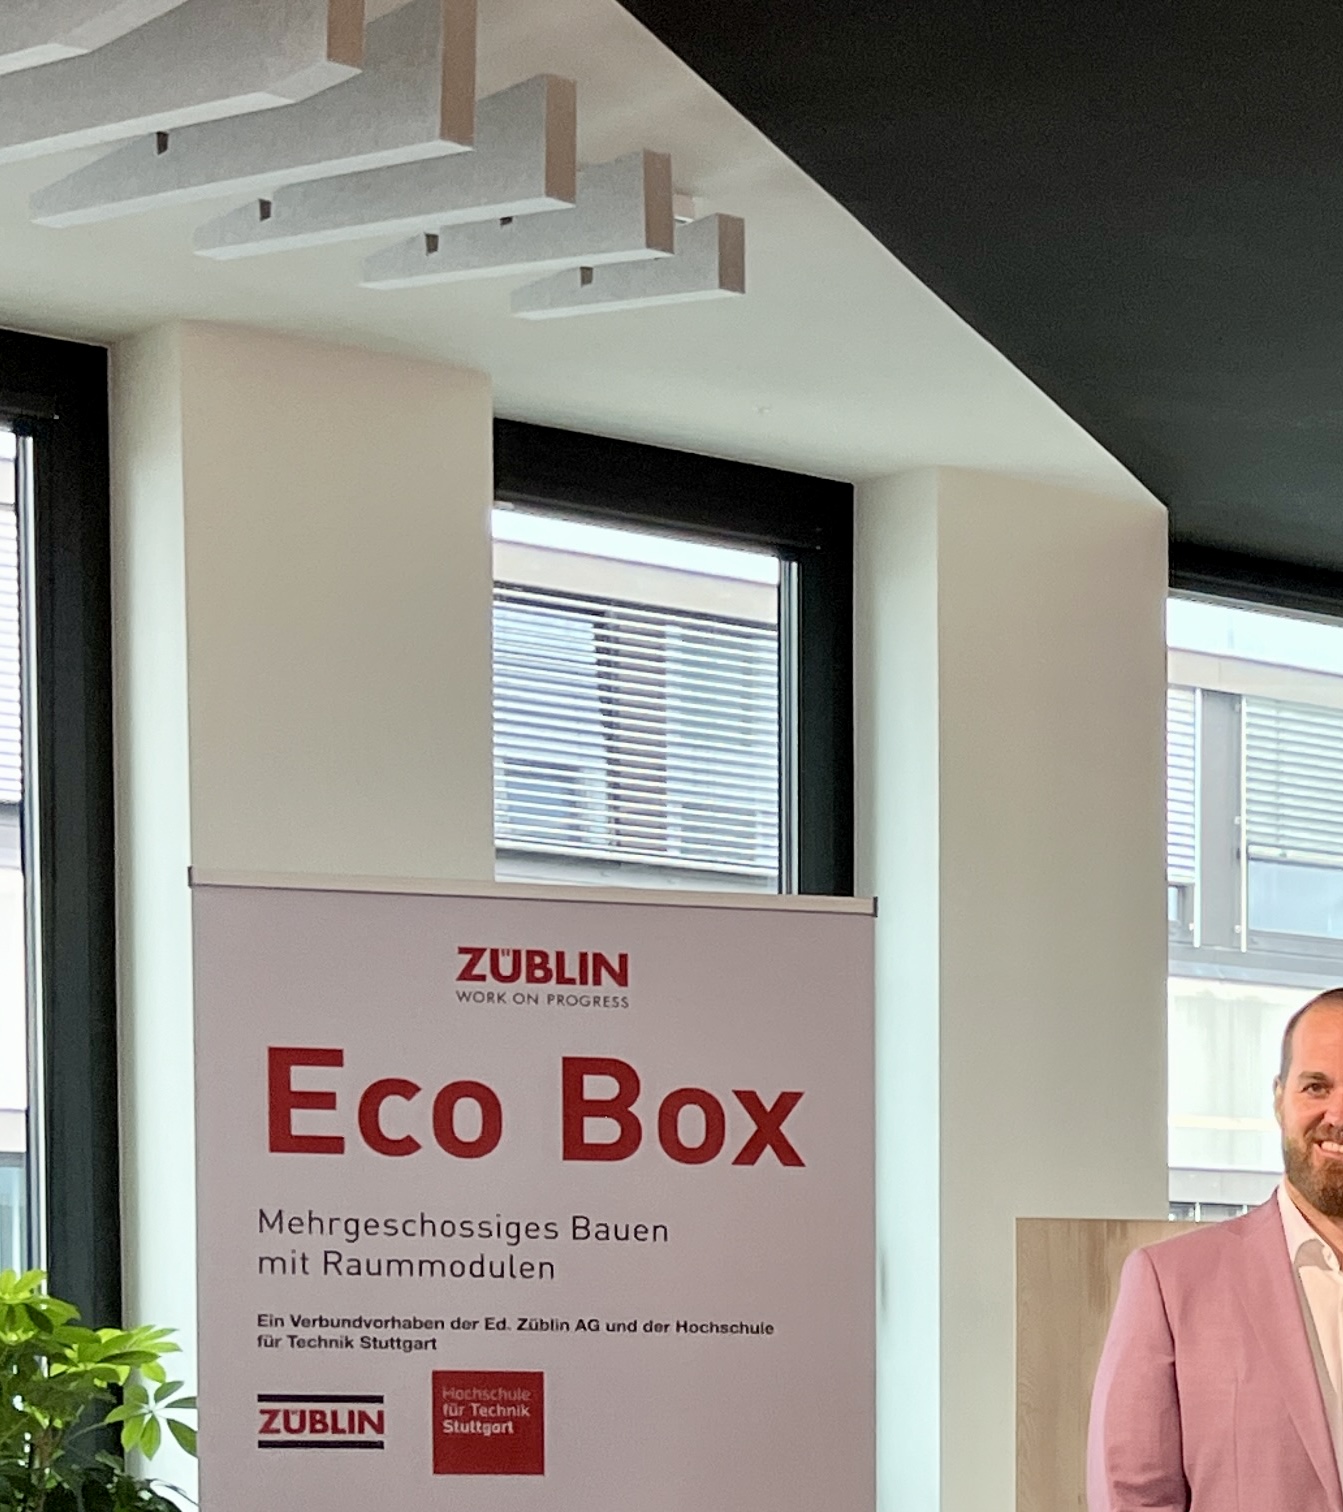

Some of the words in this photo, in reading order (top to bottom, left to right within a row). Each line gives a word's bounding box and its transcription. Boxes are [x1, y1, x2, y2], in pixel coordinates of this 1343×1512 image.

[456, 946, 629, 987] ZÜBLIN
[456, 990, 507, 1005] WORK
[512, 992, 539, 1006] ON
[546, 993, 630, 1009] PROGRESS
[266, 1045, 503, 1160] Eco
[560, 1056, 807, 1168] Box
[257, 1208, 559, 1246] Mehrgeschossiges
[570, 1214, 669, 1243] Bauen
[257, 1250, 310, 1278] mit
[323, 1251, 556, 1281] Raummodulen
[257, 1313, 285, 1328] Ein
[289, 1313, 445, 1331] Verbundvorhaben
[449, 1316, 480, 1331] der
[484, 1317, 512, 1332] Ed.
[516, 1317, 570, 1332] Züblin
[574, 1318, 601, 1333] AG
[605, 1319, 638, 1333] und
[642, 1320, 670, 1334] der
[675, 1320, 775, 1336] Hochschule
[257, 1334, 282, 1349] für
[287, 1334, 355, 1349] Technik
[359, 1335, 438, 1353] Stuttgart
[442, 1386, 532, 1401] Hochschule
[258, 1408, 385, 1435] ZÜBLIN
[442, 1402, 465, 1417] für
[470, 1402, 531, 1418] Technik
[442, 1419, 515, 1437] Stuttgart
